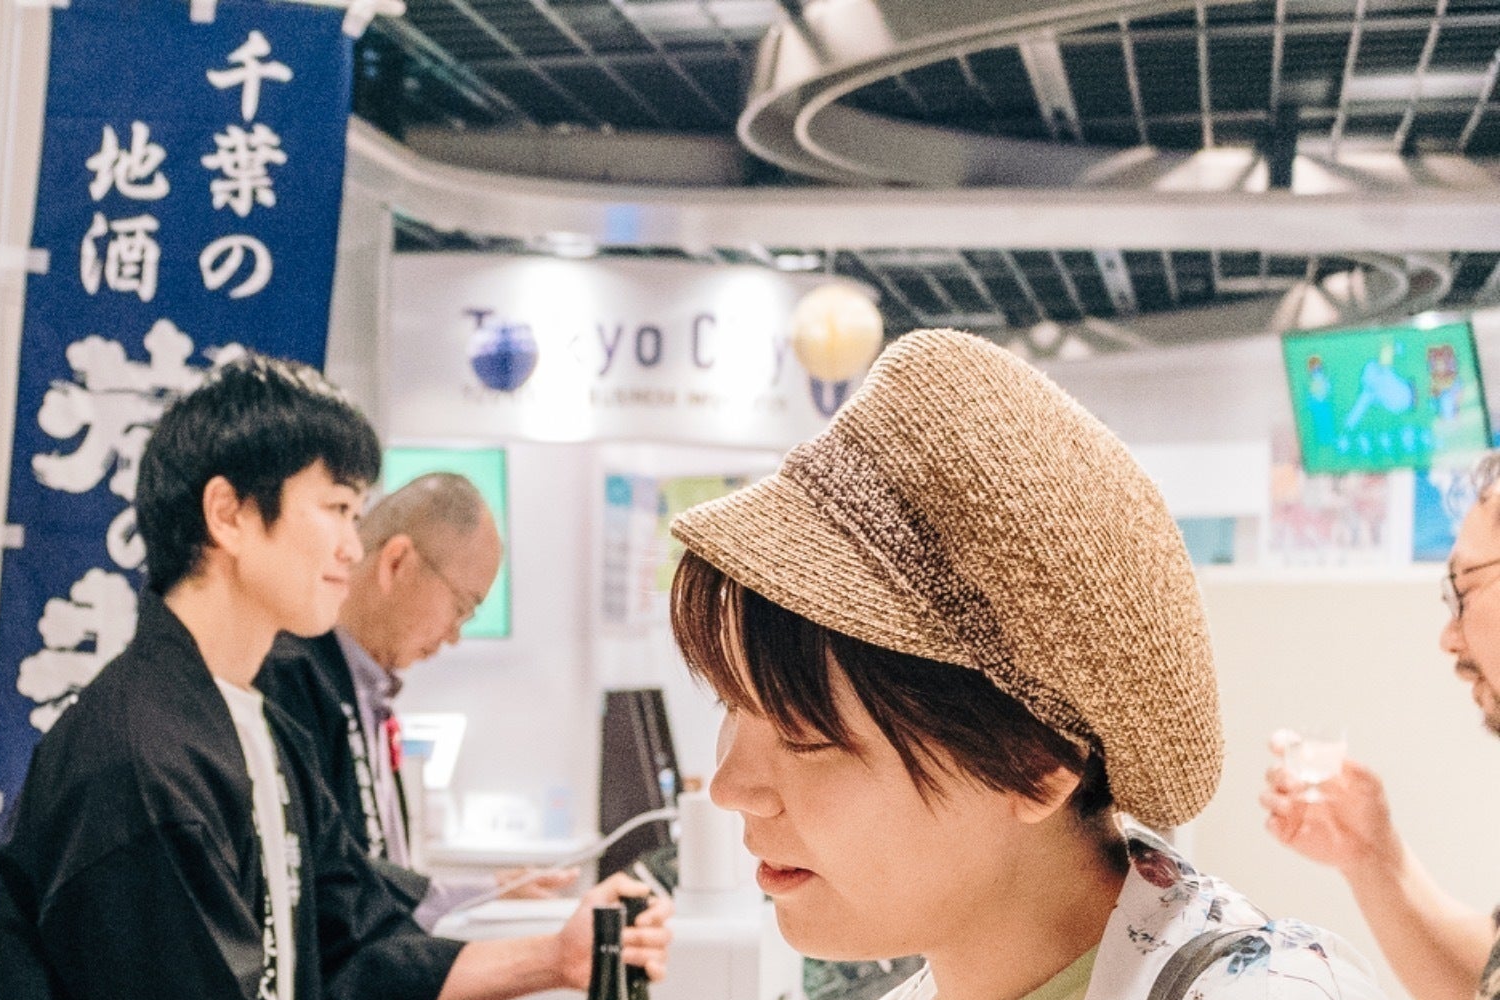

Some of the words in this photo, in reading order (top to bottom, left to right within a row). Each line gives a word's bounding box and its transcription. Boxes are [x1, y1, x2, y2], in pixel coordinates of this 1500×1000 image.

[80, 119, 170, 303] 地酒
[199, 29, 295, 300] 千葉の
